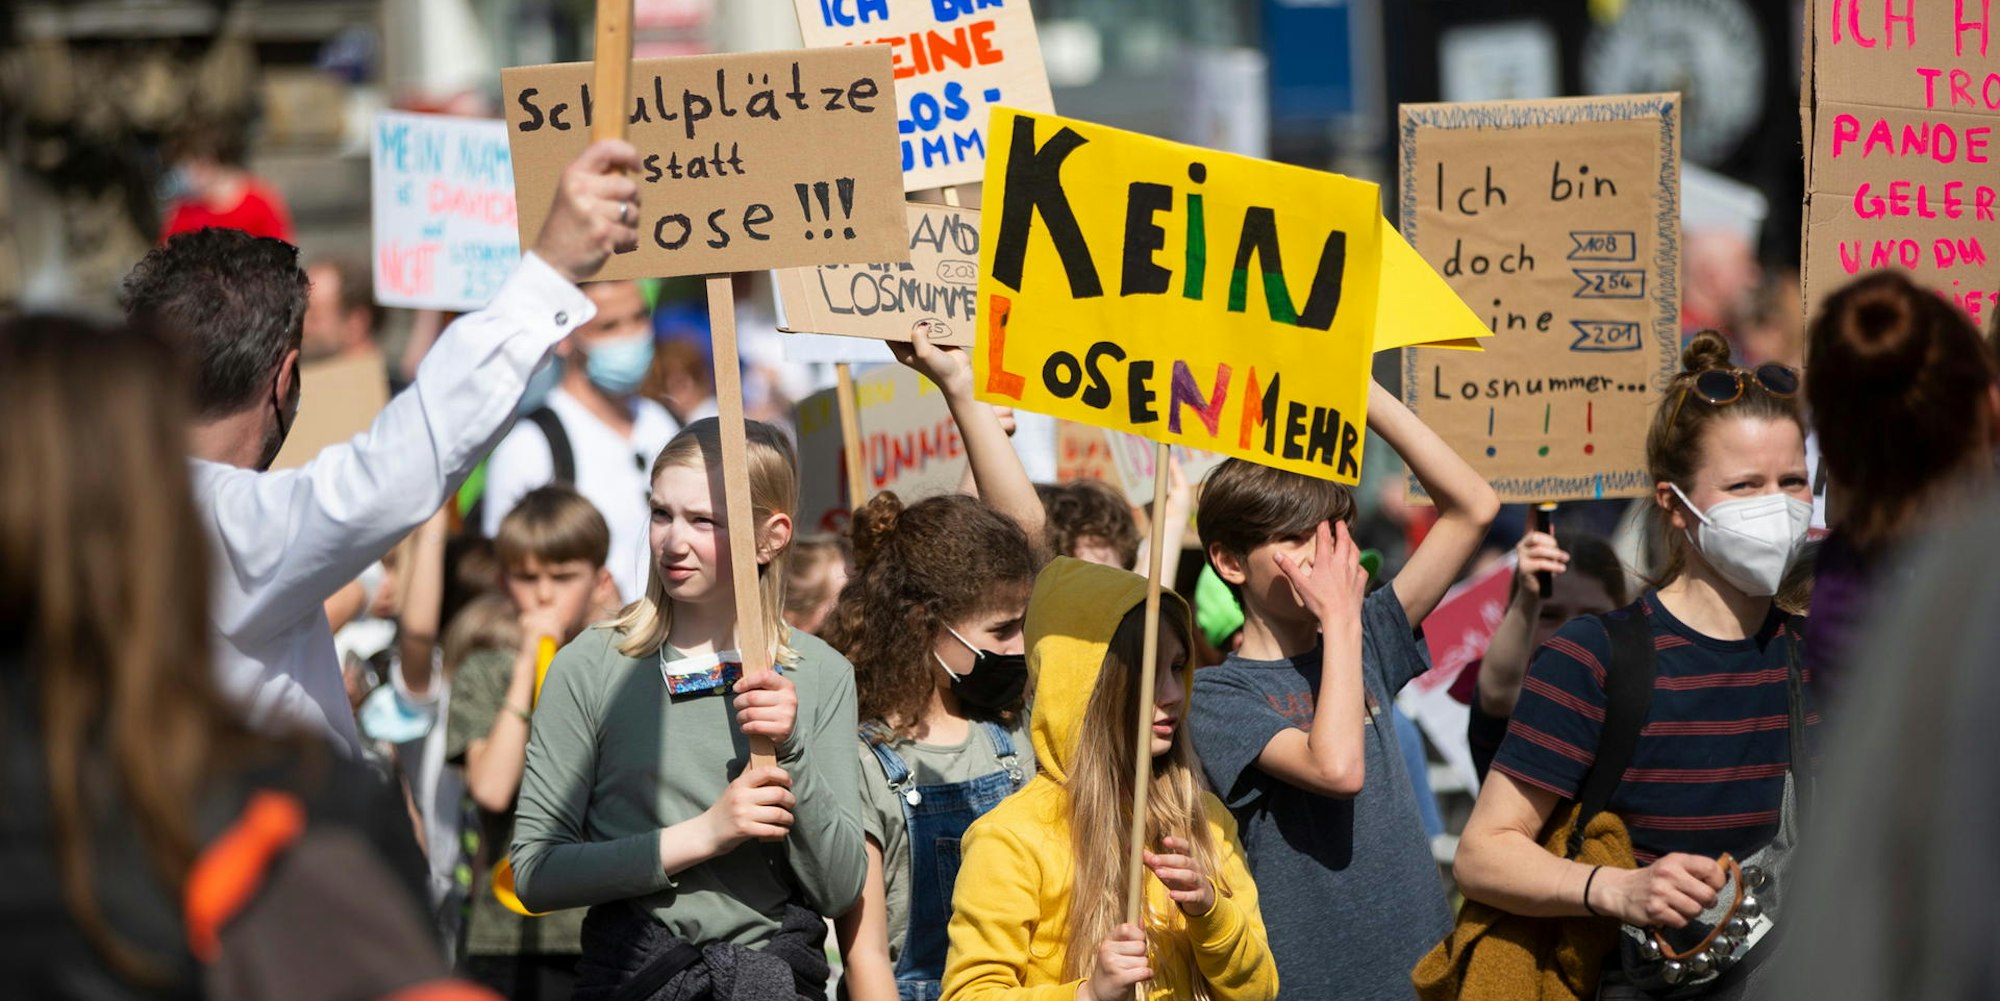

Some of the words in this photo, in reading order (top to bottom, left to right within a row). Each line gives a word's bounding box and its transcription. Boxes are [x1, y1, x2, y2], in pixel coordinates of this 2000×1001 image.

[844, 20, 1004, 80] EINE
[1832, 0, 1916, 49] ICH
[1955, 0, 1990, 57] H
[1916, 67, 2000, 110] TRO
[1832, 113, 1991, 164] PANDE
[643, 142, 746, 183] statt
[1437, 161, 1507, 216] Ich
[1551, 161, 1617, 201] bin
[1853, 180, 1996, 222] GELER
[614, 203, 774, 255] ose
[1443, 238, 1535, 278] doch
[1839, 238, 1920, 275] UND
[1594, 274, 1633, 294] 254
[1491, 298, 1553, 332] ine
[985, 293, 1232, 439] LOSEN
[1238, 365, 1359, 479] MEHR
